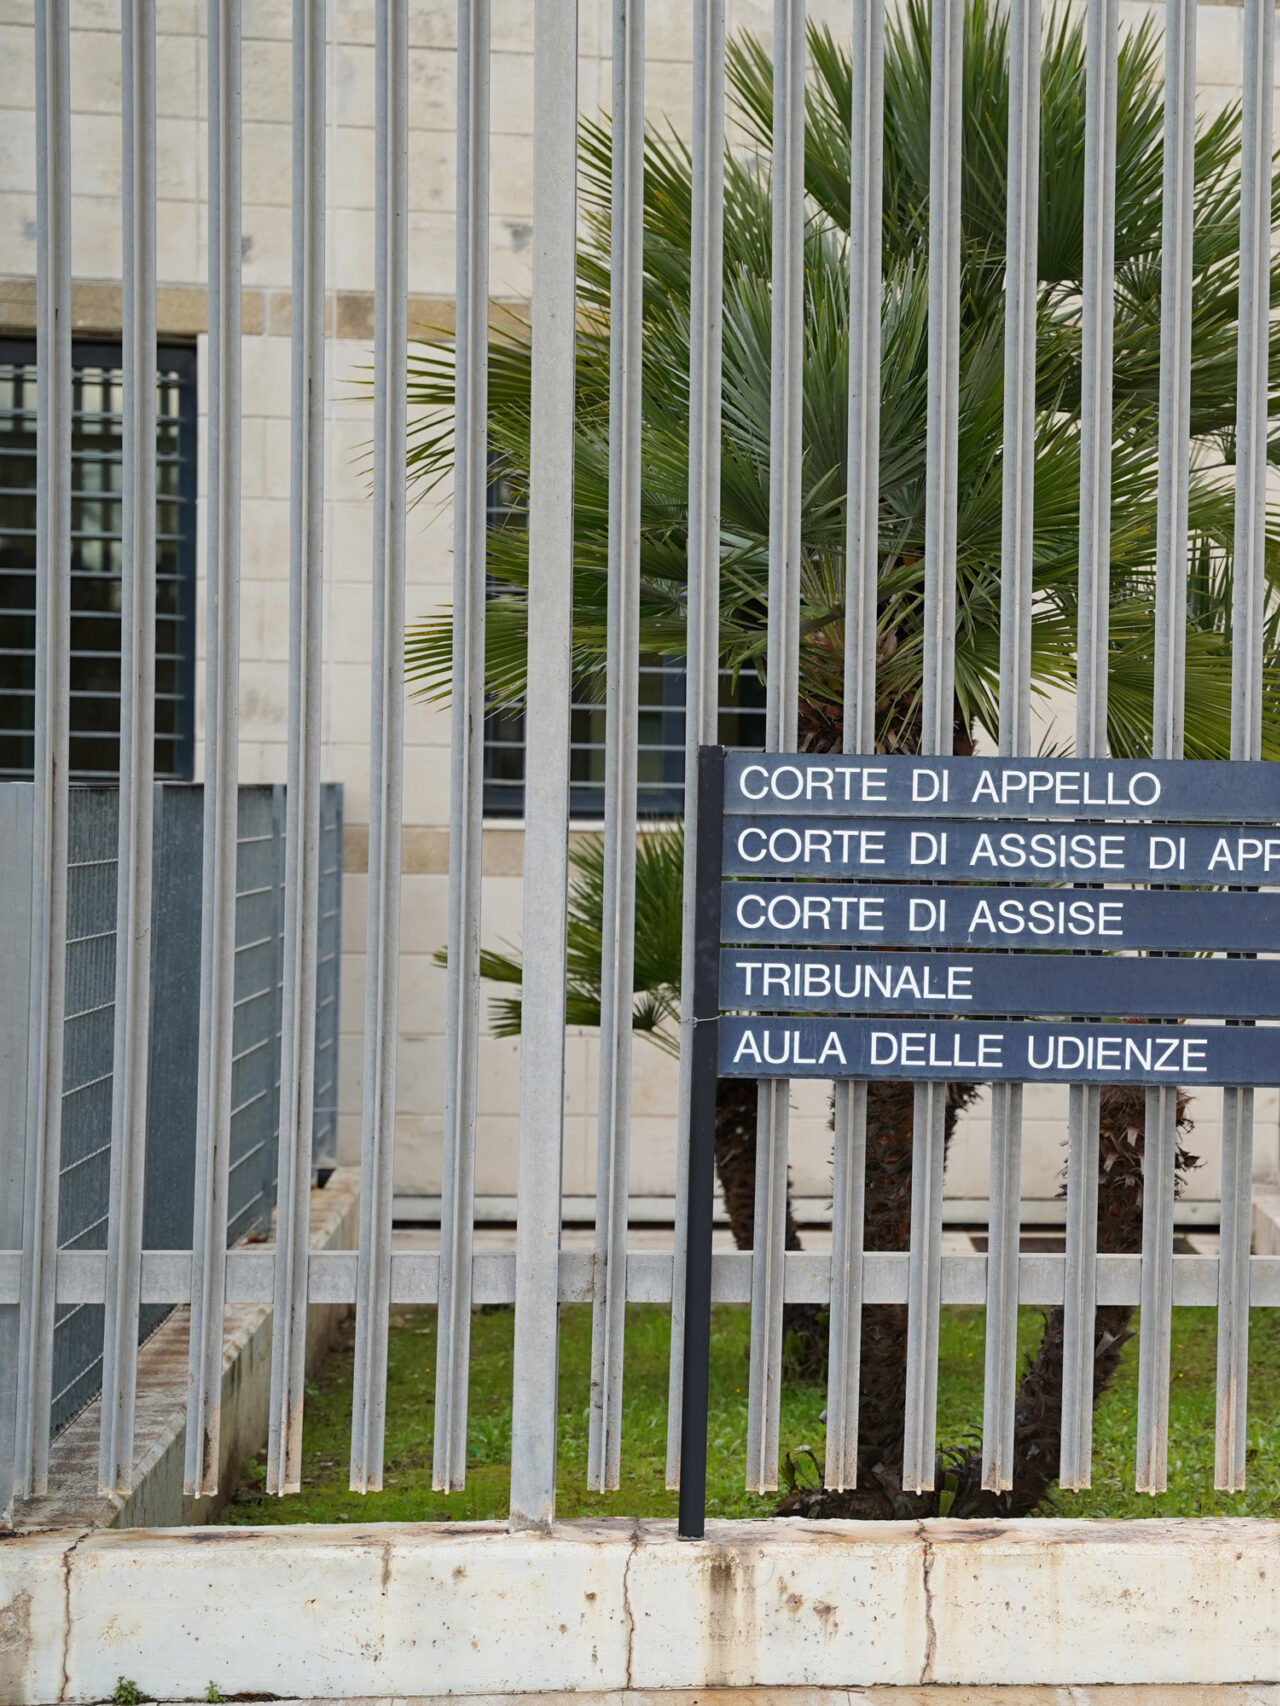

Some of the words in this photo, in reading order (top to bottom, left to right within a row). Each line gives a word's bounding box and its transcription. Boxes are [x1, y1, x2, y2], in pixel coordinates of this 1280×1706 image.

[739, 764, 888, 802] CORTE
[911, 768, 949, 803] DI
[970, 769, 1162, 806] APPELLO
[737, 827, 886, 864] CORTE
[910, 831, 948, 866] DI
[969, 832, 1126, 869] ASSISE
[1149, 836, 1186, 870] DI
[736, 894, 885, 931] CORTE
[908, 898, 946, 933] DI
[968, 899, 1124, 936] ASSISE
[735, 962, 974, 1000] TRIBUNALE
[732, 1029, 848, 1065] AULA
[870, 1031, 1004, 1068] DELLE
[1027, 1035, 1208, 1072] UDIENZE
